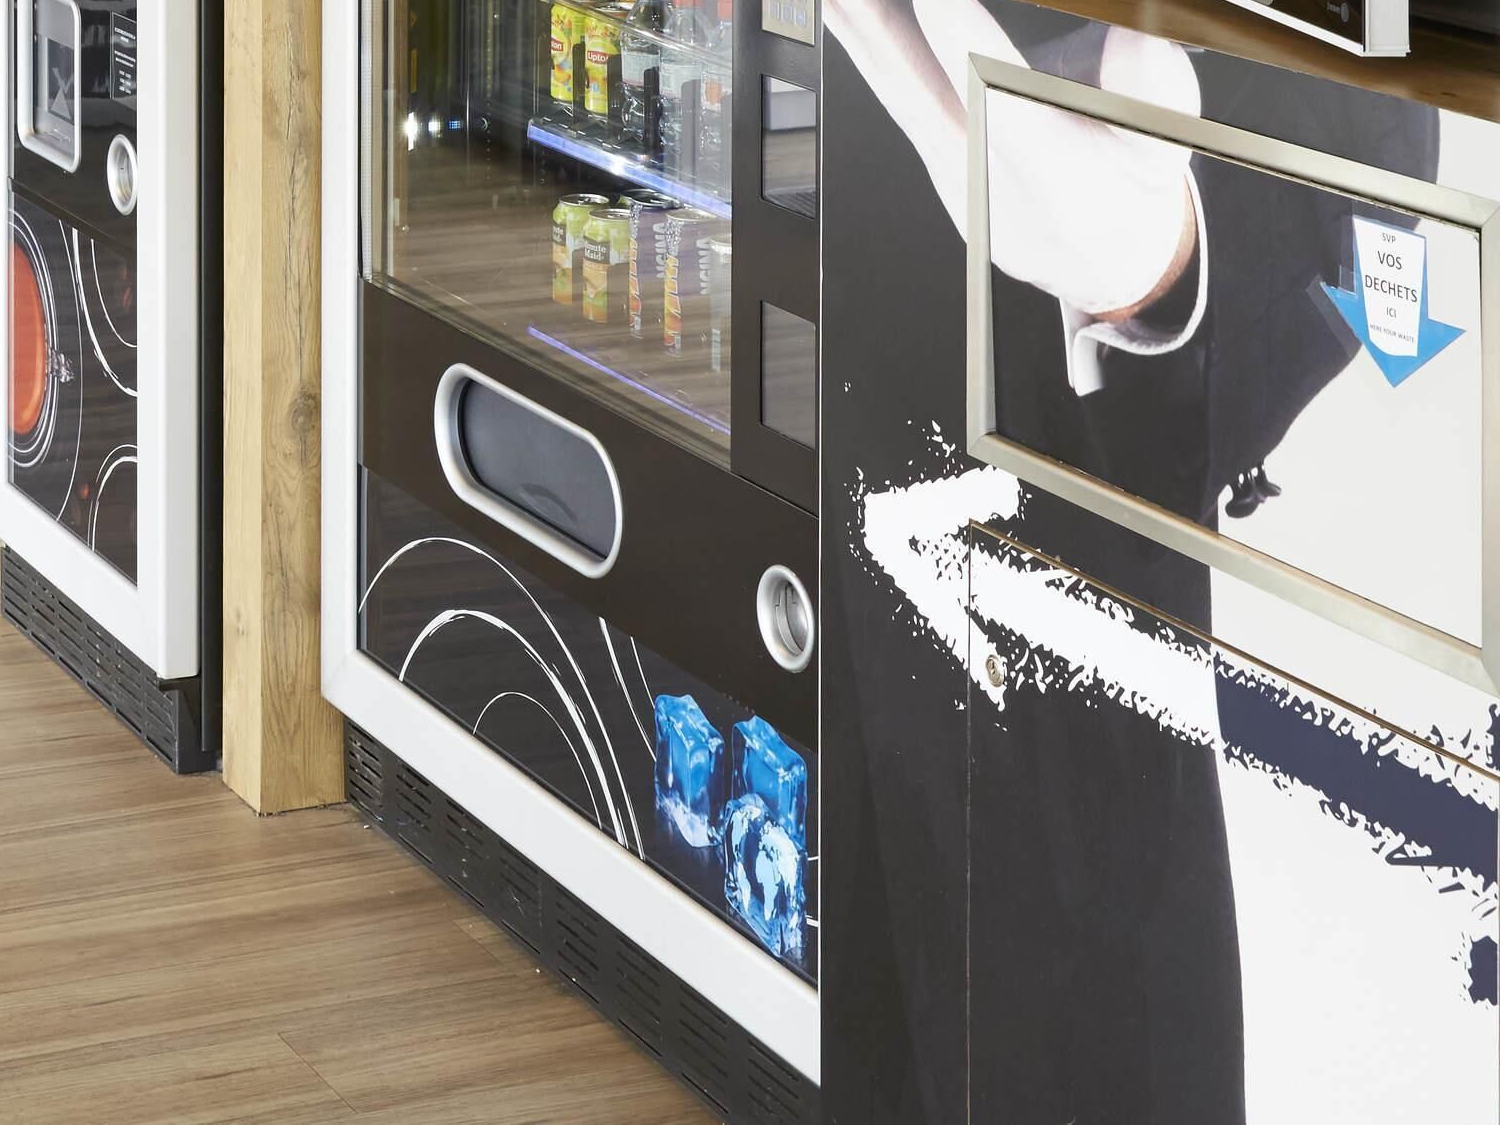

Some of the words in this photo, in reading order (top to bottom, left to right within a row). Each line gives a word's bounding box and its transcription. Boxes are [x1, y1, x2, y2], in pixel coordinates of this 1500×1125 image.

[1381, 232, 1397, 244] SVP
[1377, 250, 1403, 271] VOS
[1364, 274, 1419, 304] DECHETS
[1386, 306, 1397, 319] ICI
